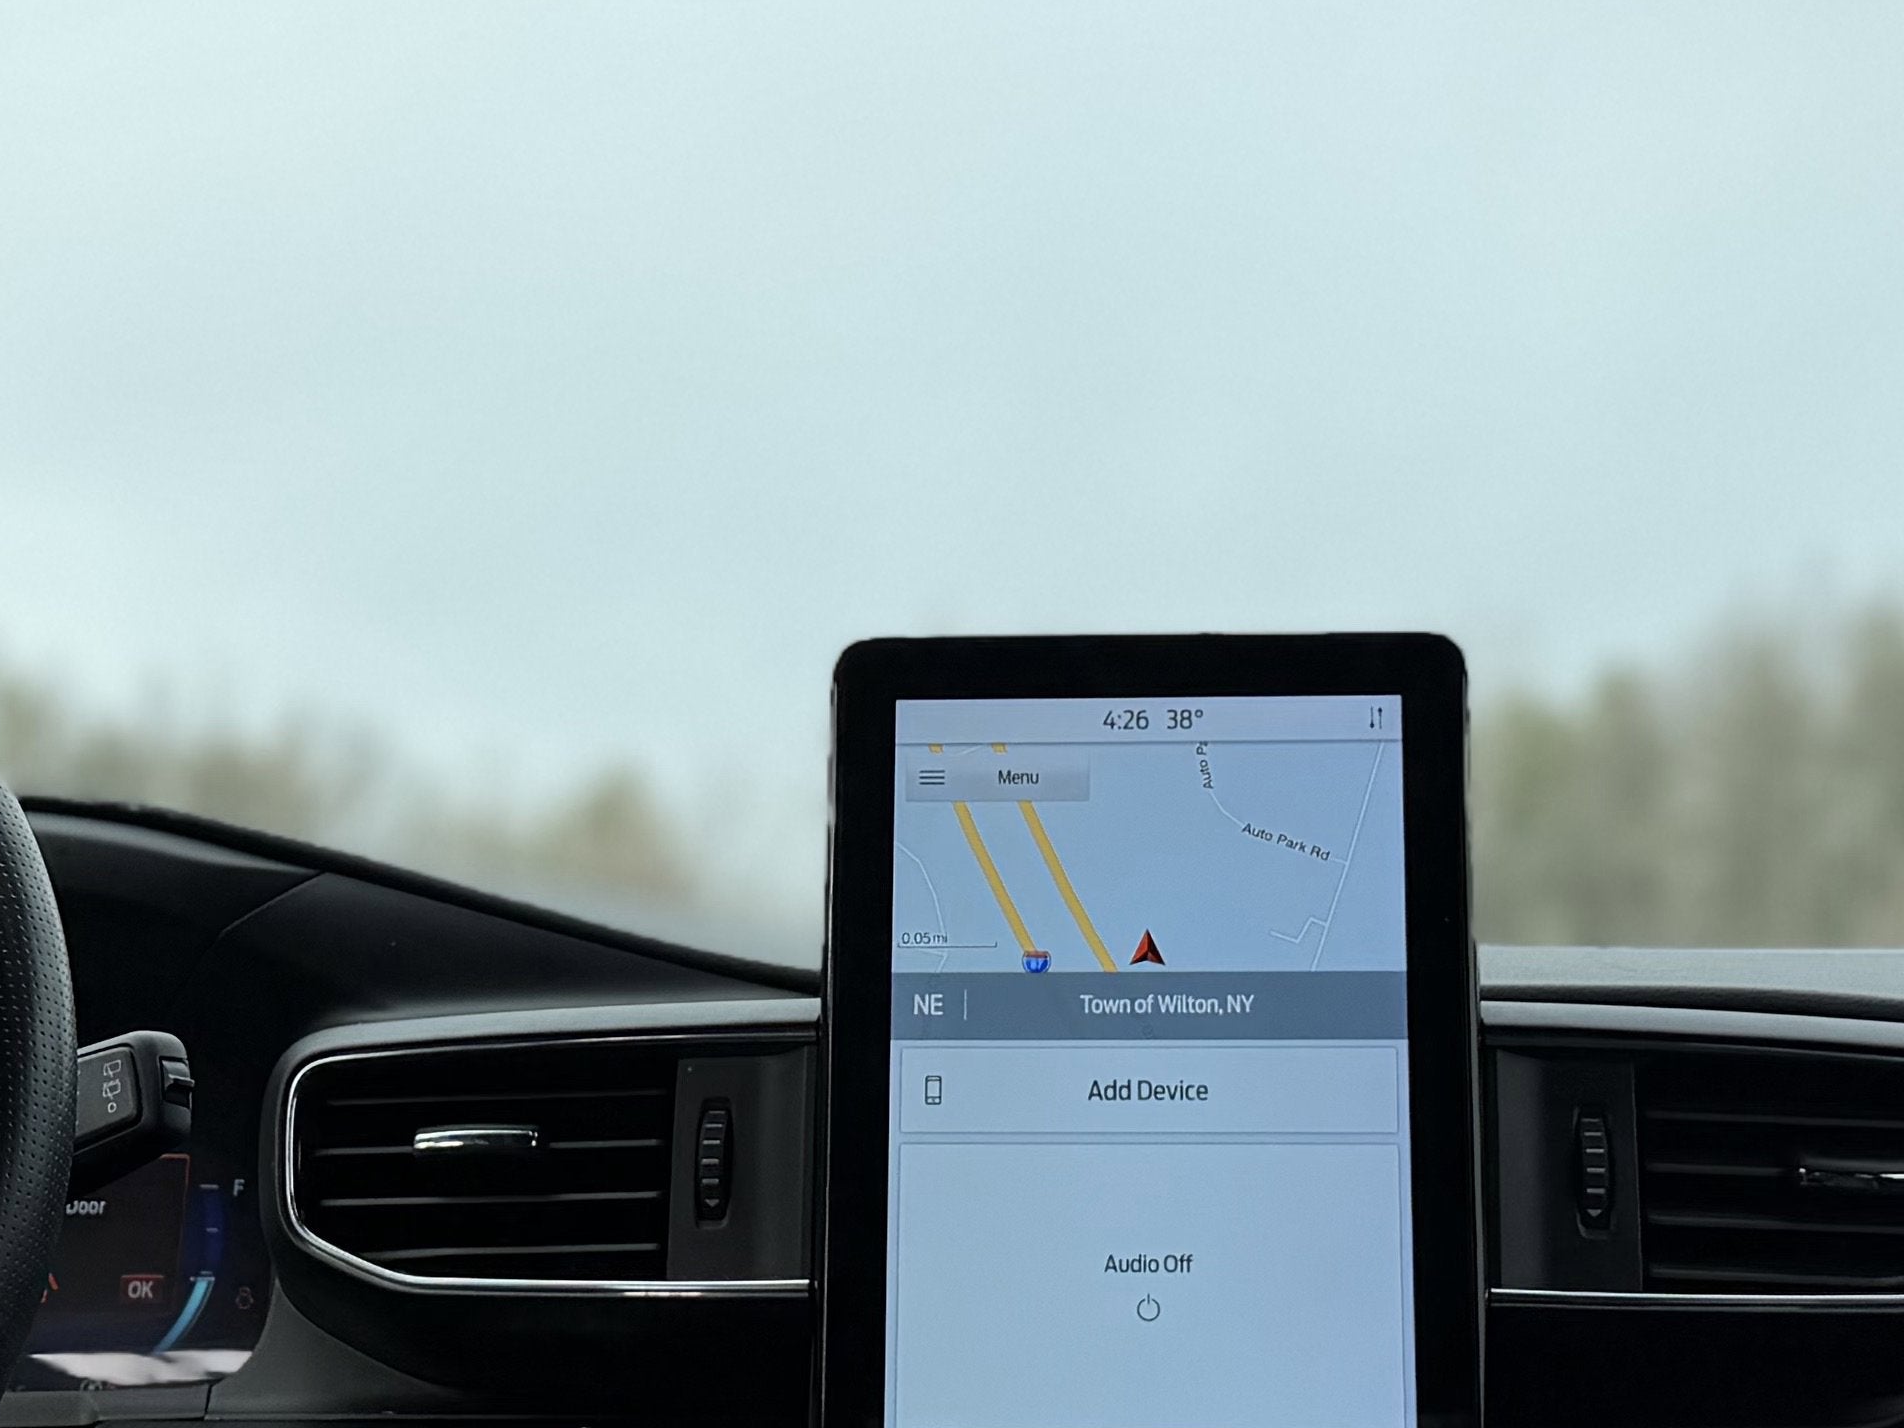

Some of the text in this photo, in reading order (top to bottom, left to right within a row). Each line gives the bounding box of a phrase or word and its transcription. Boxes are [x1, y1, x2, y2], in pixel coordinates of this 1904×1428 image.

[1102, 709, 1204, 731] 4:26 38°
[998, 770, 1039, 785] Menu
[1199, 759, 1214, 790] Auto
[1242, 823, 1331, 861] Auto Park Rd
[901, 932, 931, 945] 0.05
[912, 994, 944, 1016] NE
[1080, 993, 1254, 1018] Town of Wilton, NY
[1087, 1079, 1209, 1101] Add Device
[232, 1178, 246, 1197] F
[1104, 1253, 1194, 1274] Audio Off
[127, 1280, 154, 1299] OK
